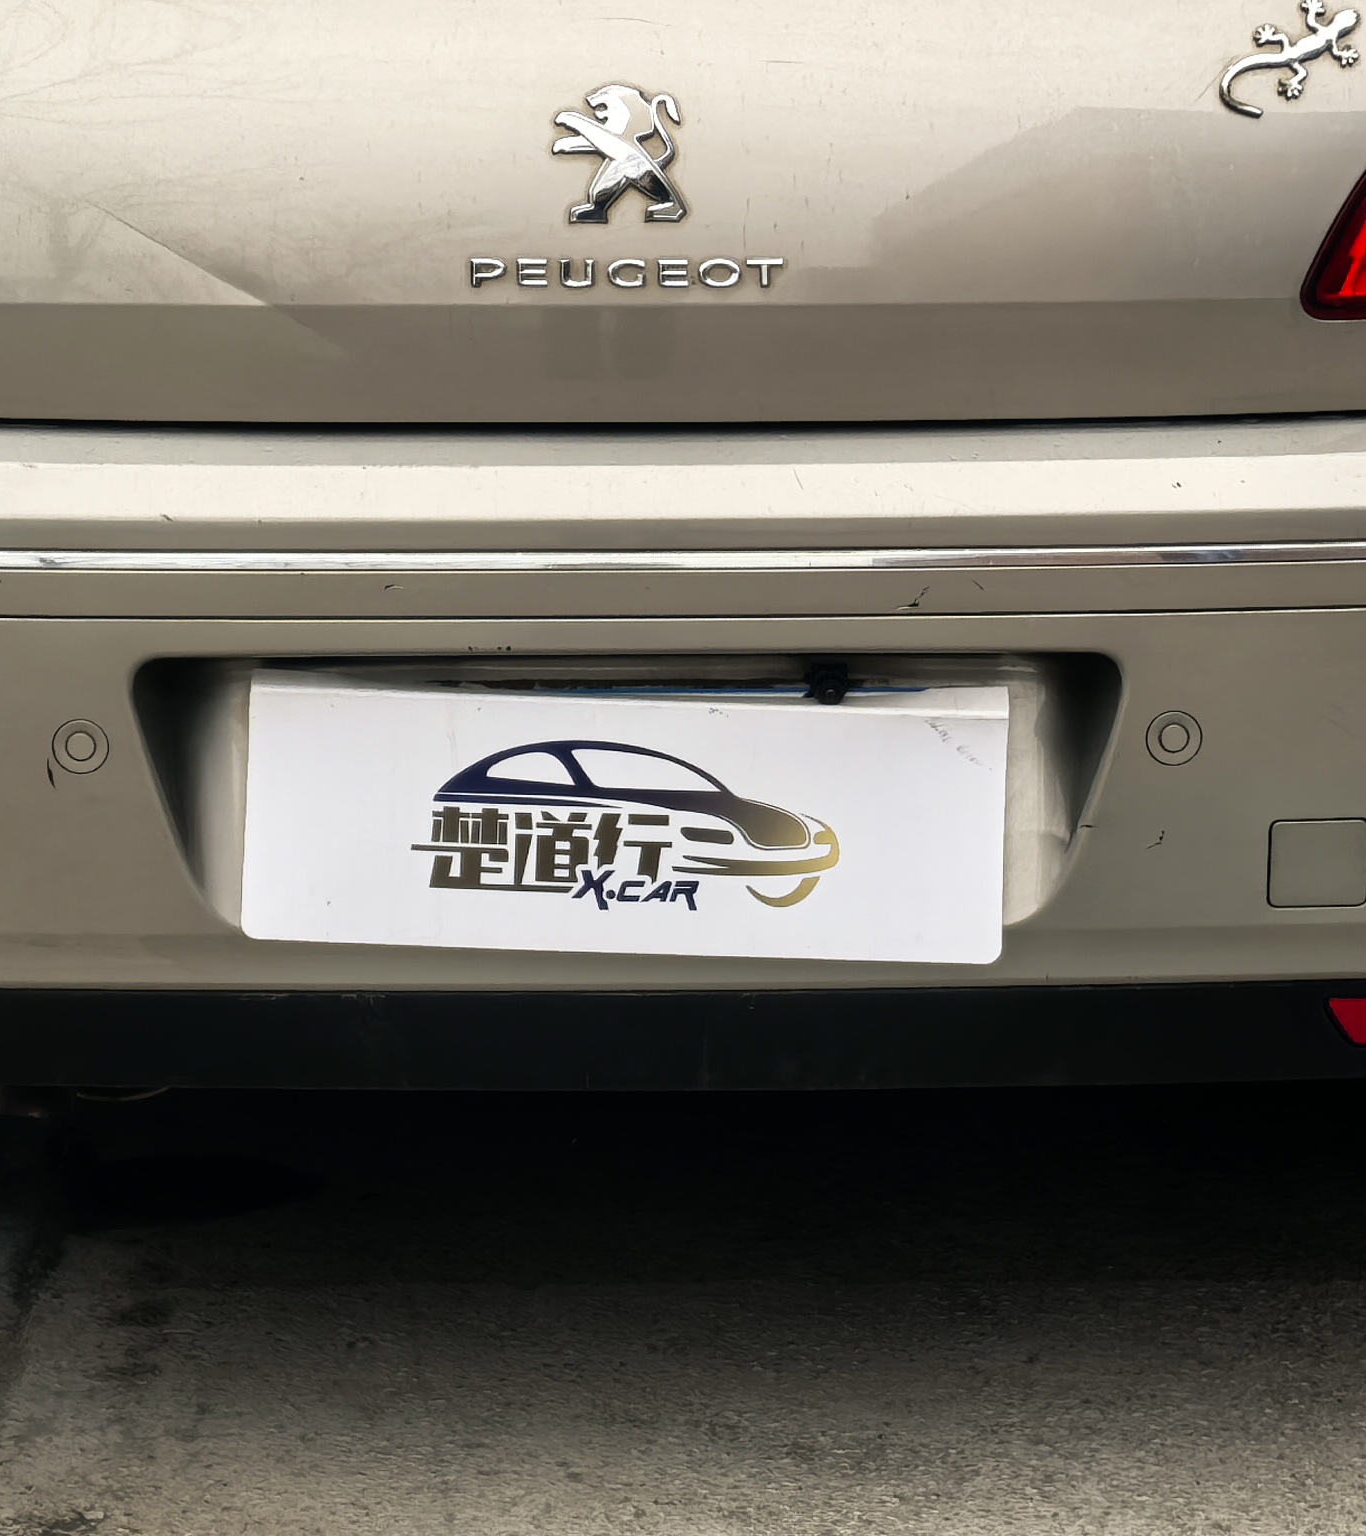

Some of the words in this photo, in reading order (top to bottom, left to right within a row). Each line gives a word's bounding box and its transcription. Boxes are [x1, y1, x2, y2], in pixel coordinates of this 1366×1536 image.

[469, 257, 785, 289] PEUGEOT
[410, 806, 673, 893] 楚道行
